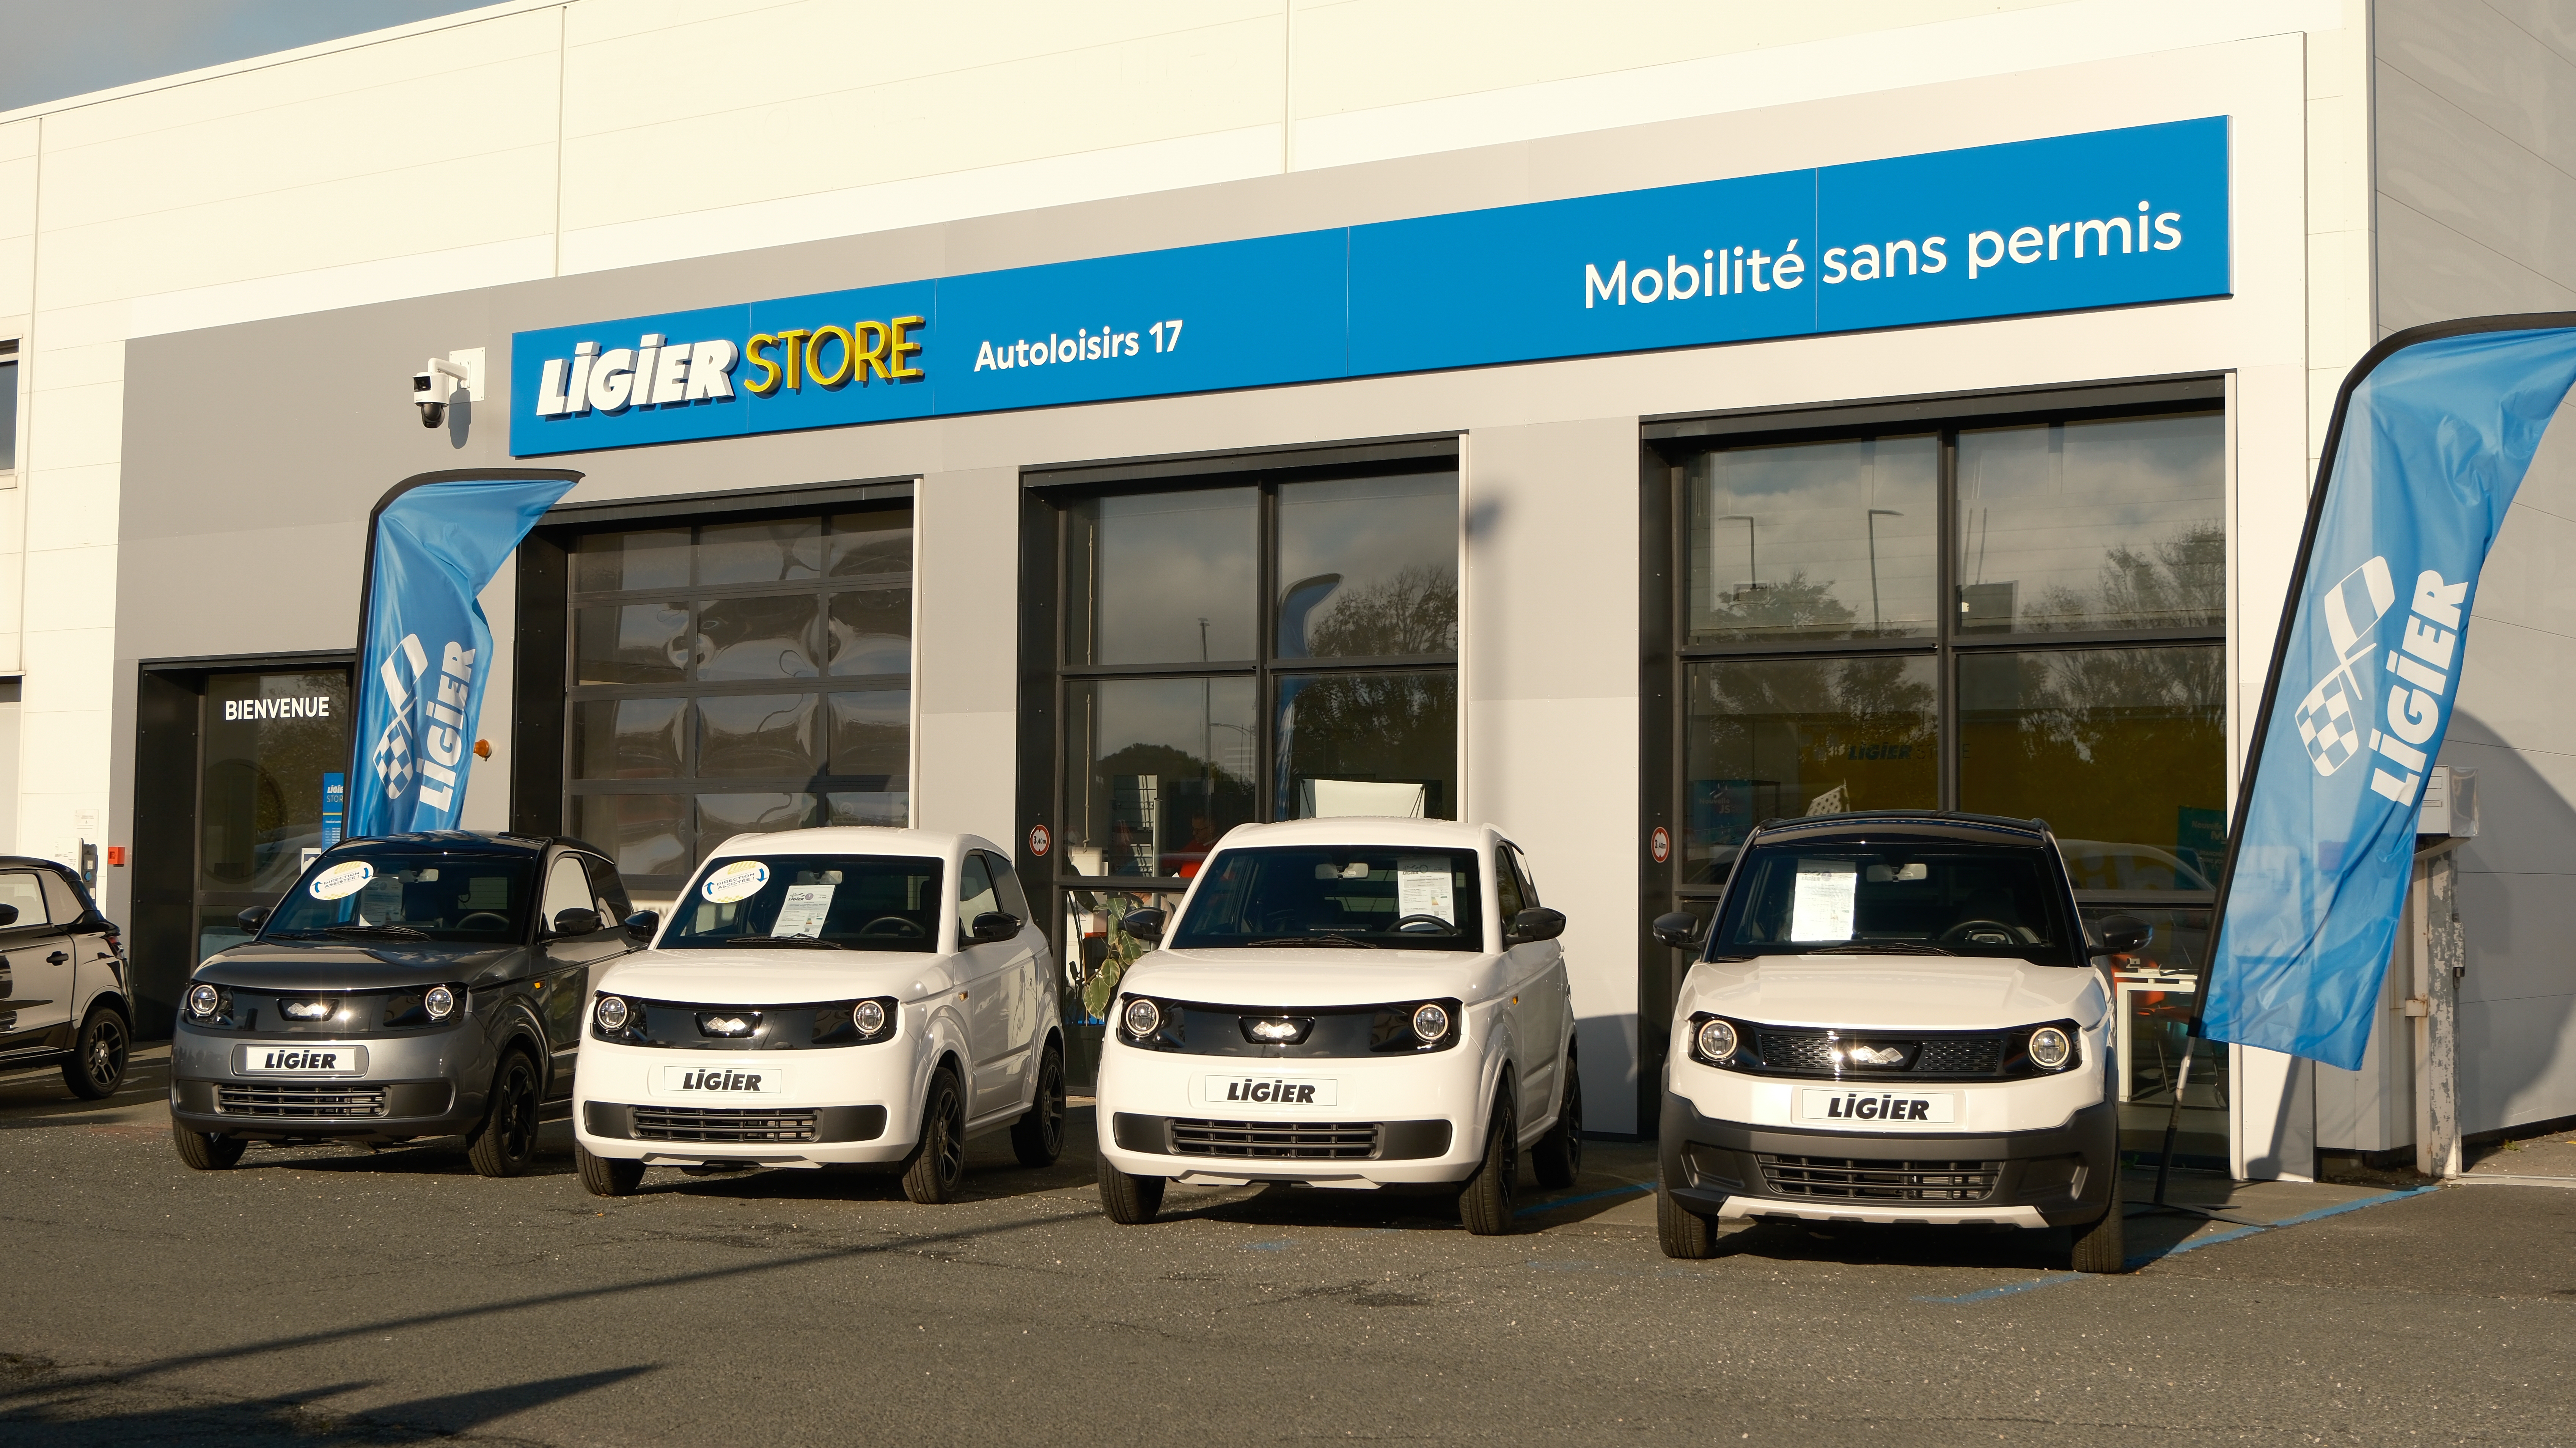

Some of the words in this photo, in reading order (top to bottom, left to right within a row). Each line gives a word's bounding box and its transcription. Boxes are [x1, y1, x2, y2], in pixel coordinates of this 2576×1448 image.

[1586, 239, 1804, 309] Mobilité
[1822, 236, 1947, 284] sans
[1968, 201, 2182, 279] permis
[744, 316, 924, 393] STORE
[974, 326, 1139, 372] Autoloisirs
[1149, 320, 1183, 353] 17
[225, 696, 329, 720] BIENVENUE
[1033, 836, 1046, 845] 3,40m
[324, 871, 360, 885] DIRECTION
[717, 873, 754, 886] DIRECTION
[718, 878, 750, 890] ASSISTÉE
